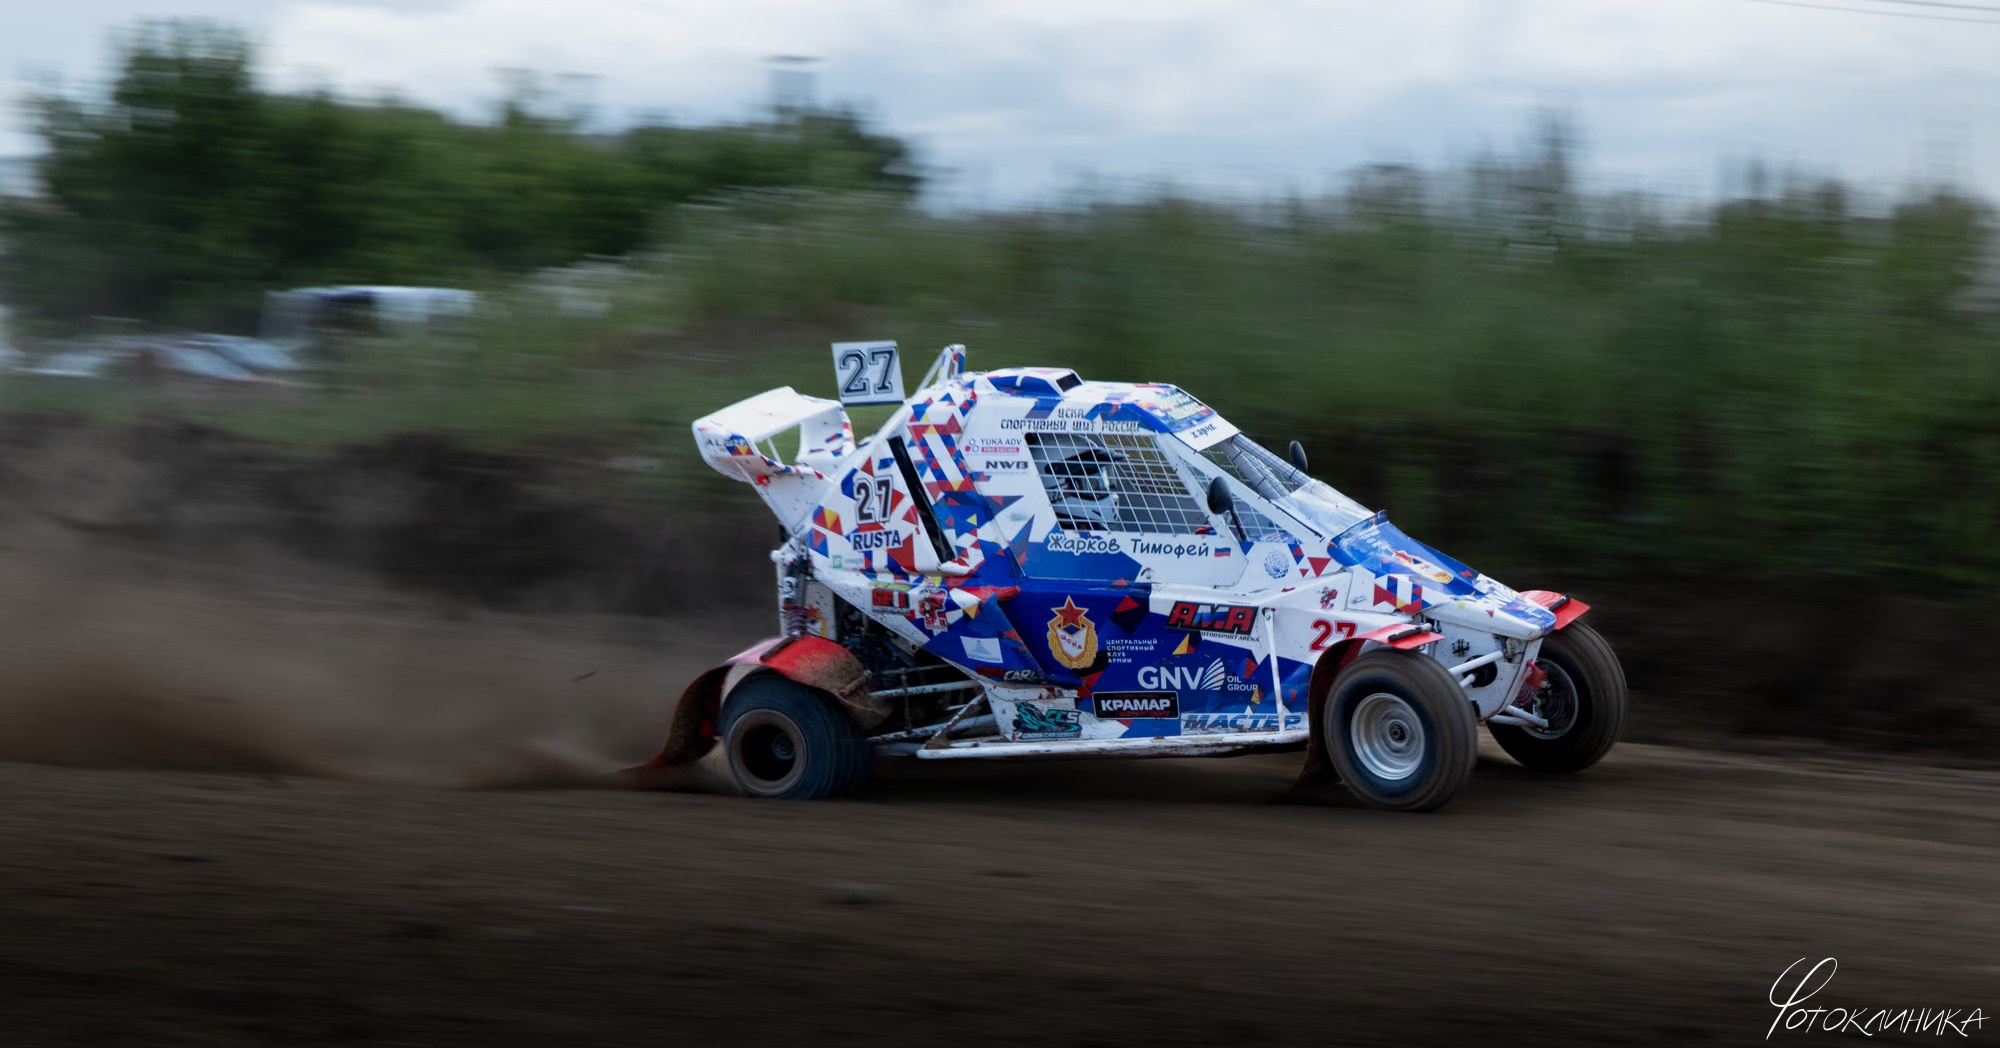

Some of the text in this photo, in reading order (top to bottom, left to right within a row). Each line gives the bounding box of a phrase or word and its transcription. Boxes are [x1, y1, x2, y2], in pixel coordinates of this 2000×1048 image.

[839, 347, 897, 398] 27
[854, 475, 893, 525] 27
[853, 530, 901, 550] RUSTA
[1050, 534, 1209, 559] Жарков Тимофей
[1198, 631, 1237, 639] OTORSPORT
[1309, 618, 1358, 652] 27
[1137, 666, 1204, 690] GNV
[1227, 675, 1242, 683] OIL
[1227, 683, 1258, 692] GROUP
[1101, 699, 1171, 711] КРАМАР
[1183, 714, 1302, 729] МАСТЕР
